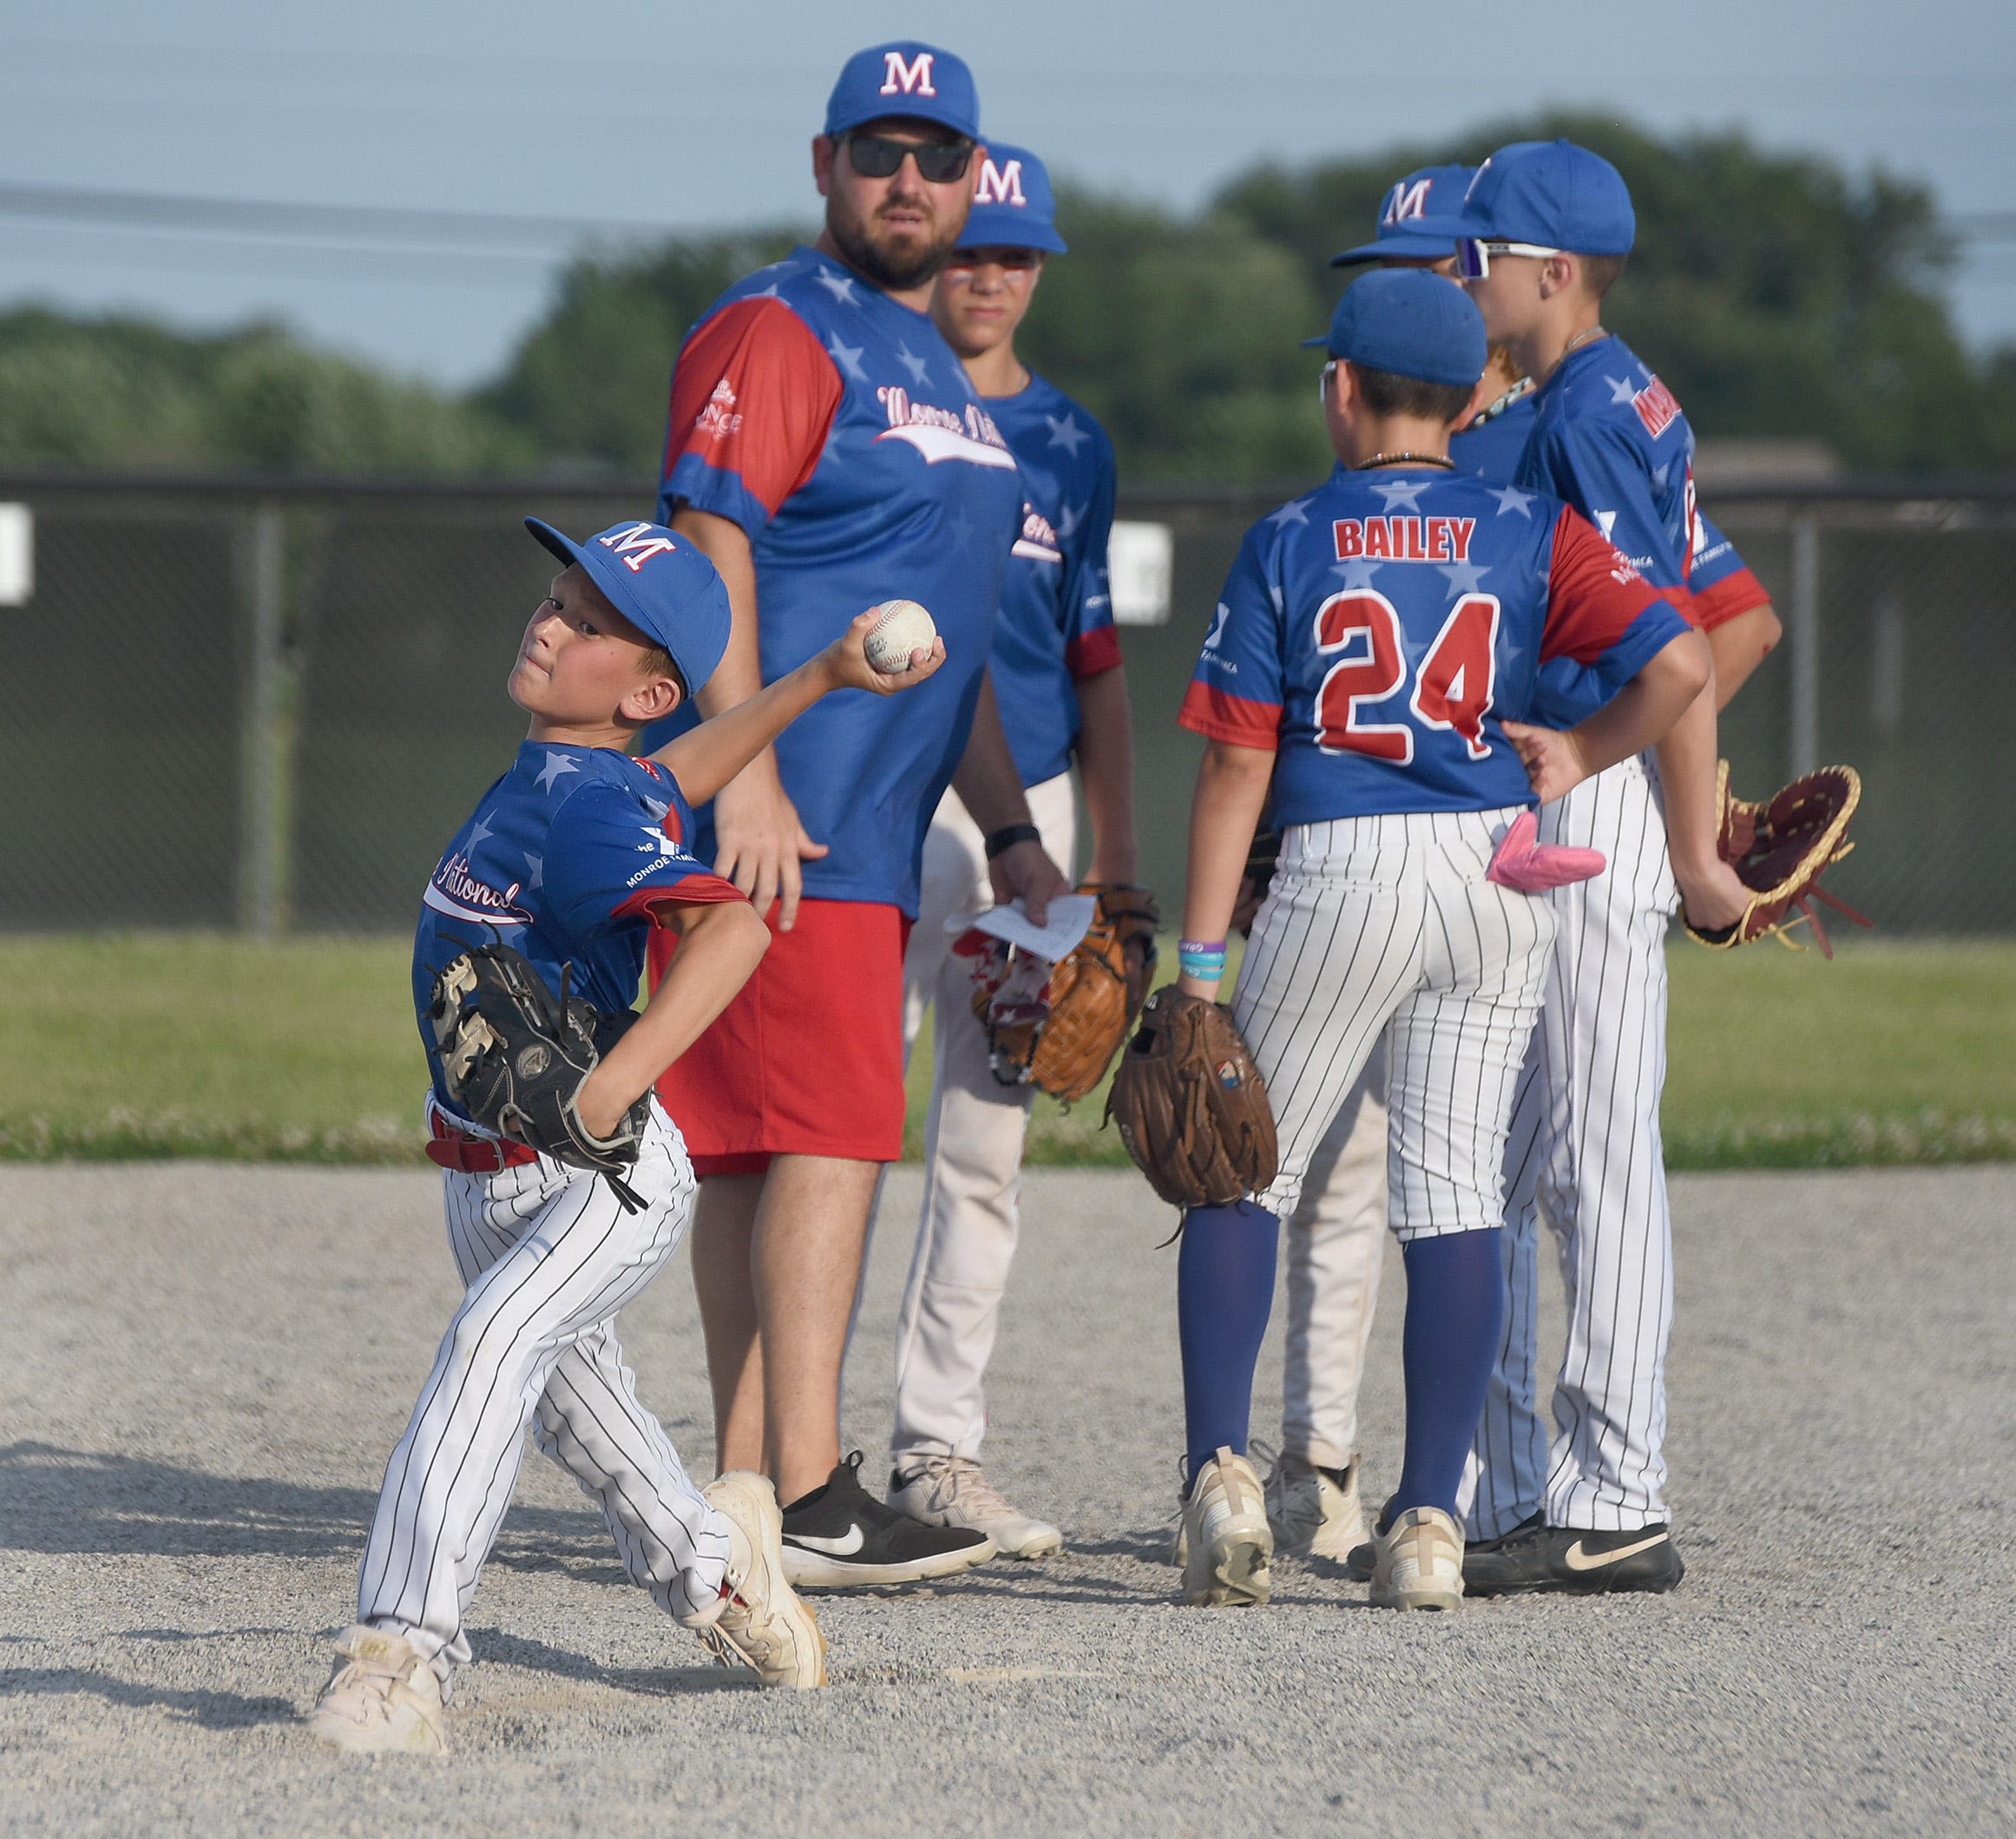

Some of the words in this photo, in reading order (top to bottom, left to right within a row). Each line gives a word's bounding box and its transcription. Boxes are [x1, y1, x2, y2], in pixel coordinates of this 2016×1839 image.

[879, 50, 937, 97] M
[973, 159, 1027, 207] M
[1382, 178, 1434, 227] M
[596, 522, 678, 575] M
[1332, 515, 1477, 563] BAILEY
[1312, 588, 1501, 767] 24
[626, 855, 671, 889] MONROE
